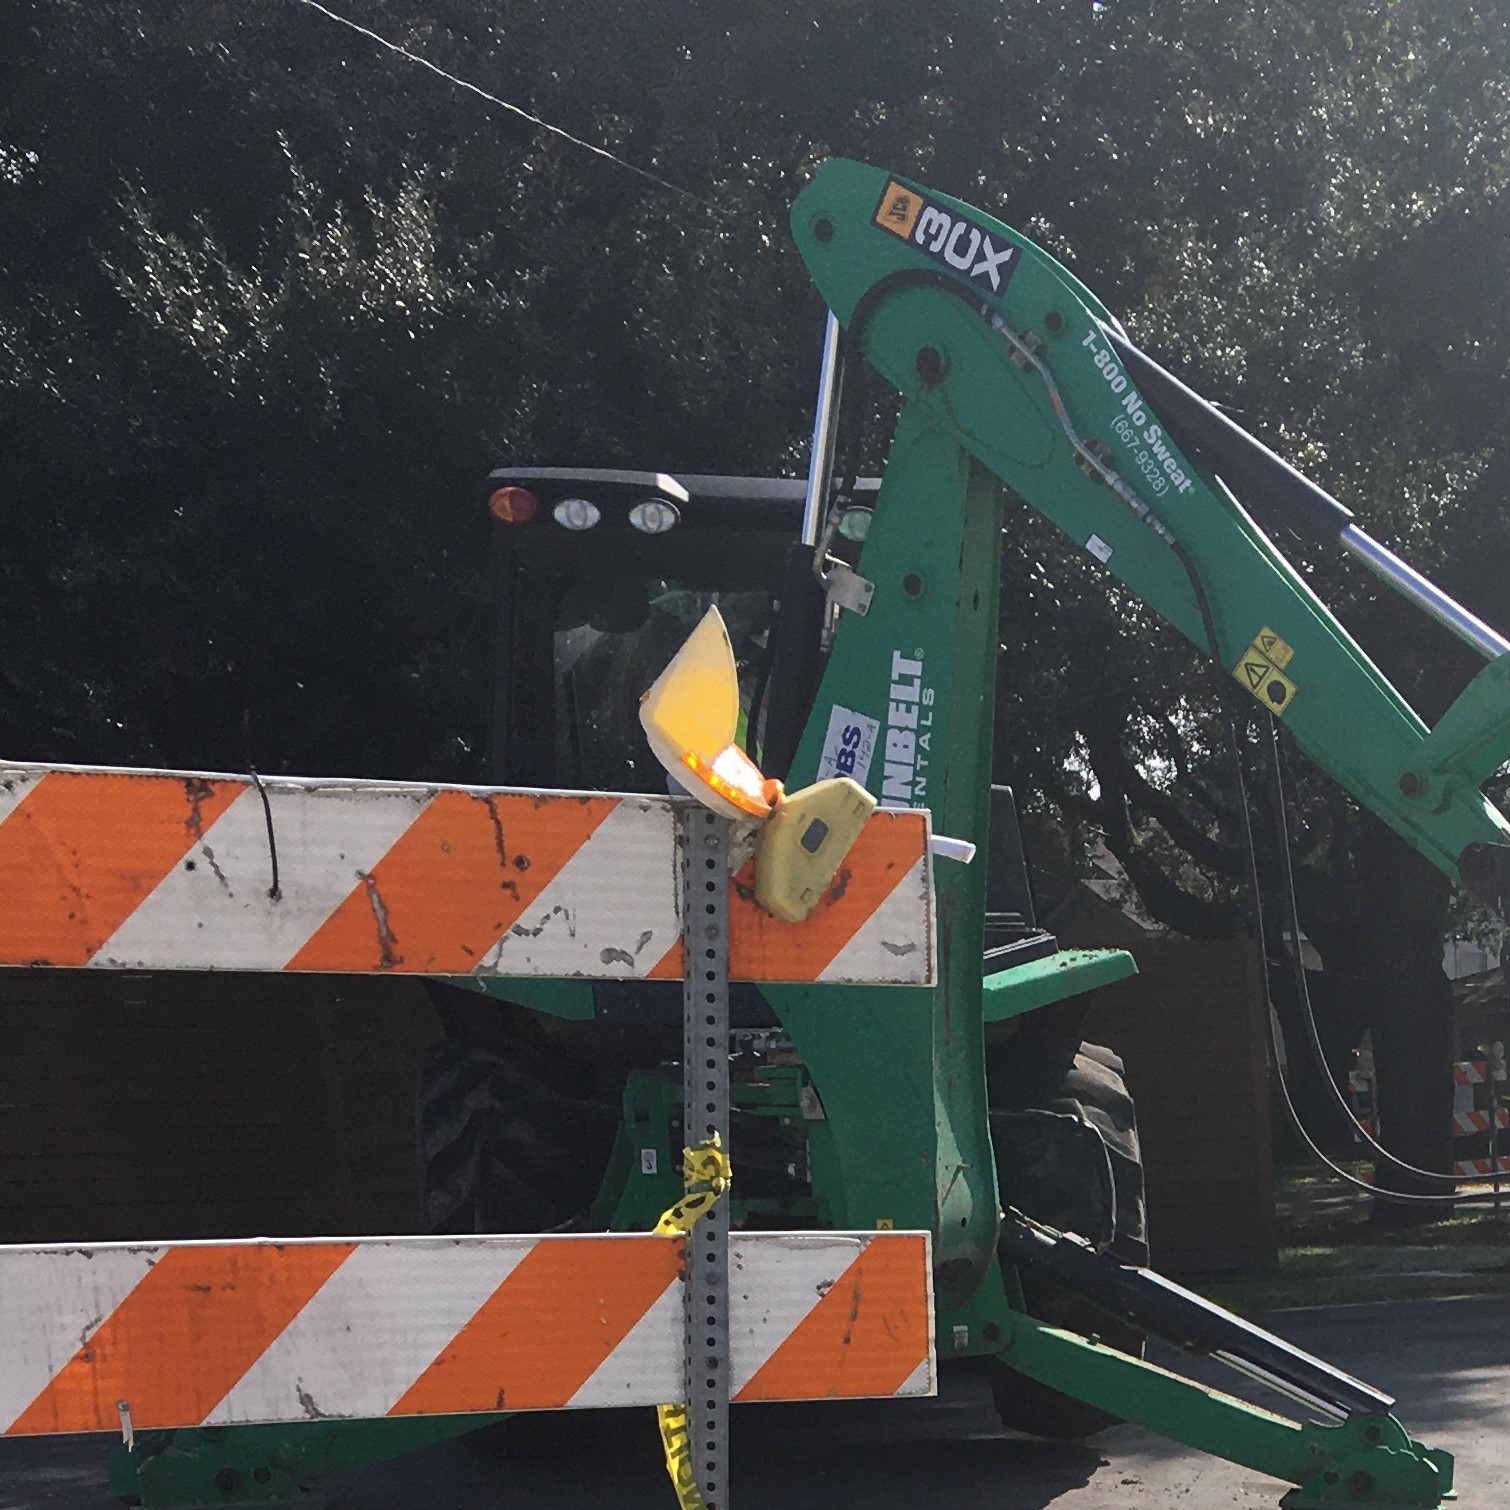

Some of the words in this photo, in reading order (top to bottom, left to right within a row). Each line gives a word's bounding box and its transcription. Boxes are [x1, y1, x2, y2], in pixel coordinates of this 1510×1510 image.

[1082, 329, 1128, 393] 1-800
[1122, 390, 1146, 426] No
[1143, 424, 1193, 493] Sweat
[834, 725, 861, 777] BS
[881, 650, 922, 808] NBELT
[912, 688, 935, 808] NTALS
